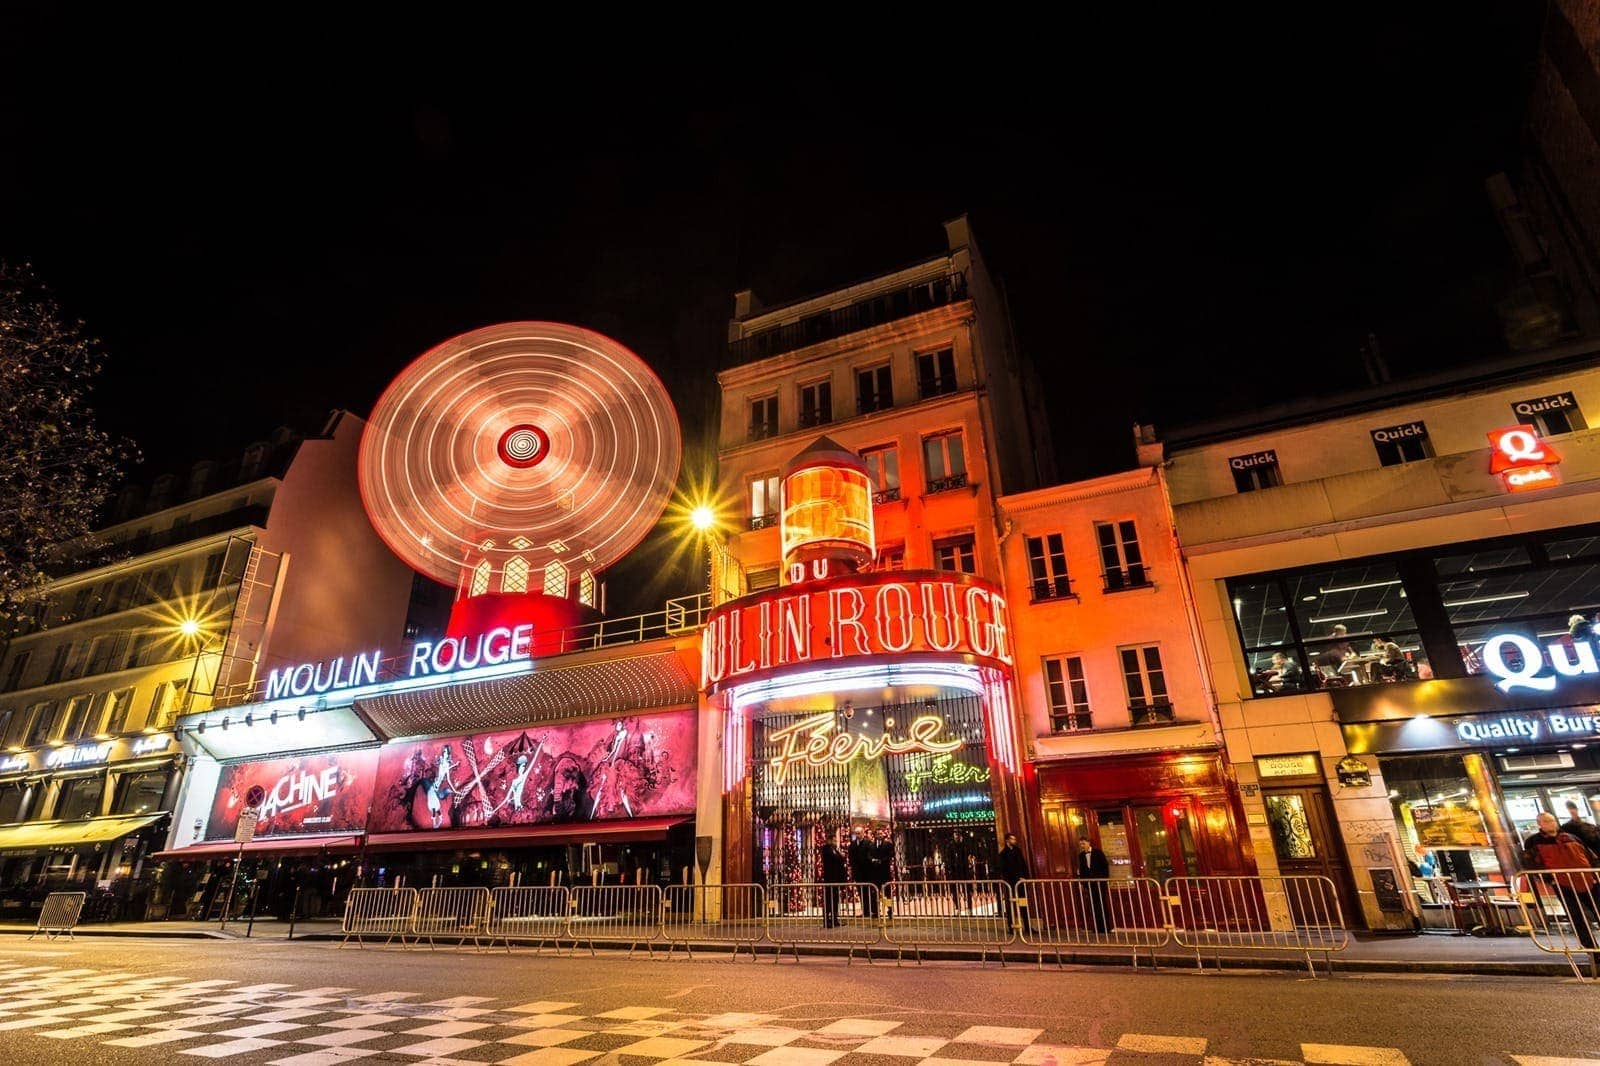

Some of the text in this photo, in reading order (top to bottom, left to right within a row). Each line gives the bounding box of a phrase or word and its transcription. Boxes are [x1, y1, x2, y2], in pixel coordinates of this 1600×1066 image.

[1515, 396, 1572, 415] Quick
[1374, 424, 1424, 442] Quick
[1499, 430, 1545, 463] Q
[1231, 452, 1275, 470] Quick
[790, 558, 828, 583] DU
[828, 582, 1013, 666] ROUGE
[264, 623, 534, 699] MOULIN ROUGE
[1482, 622, 1600, 693] Qu
[1459, 717, 1539, 741] Quality
